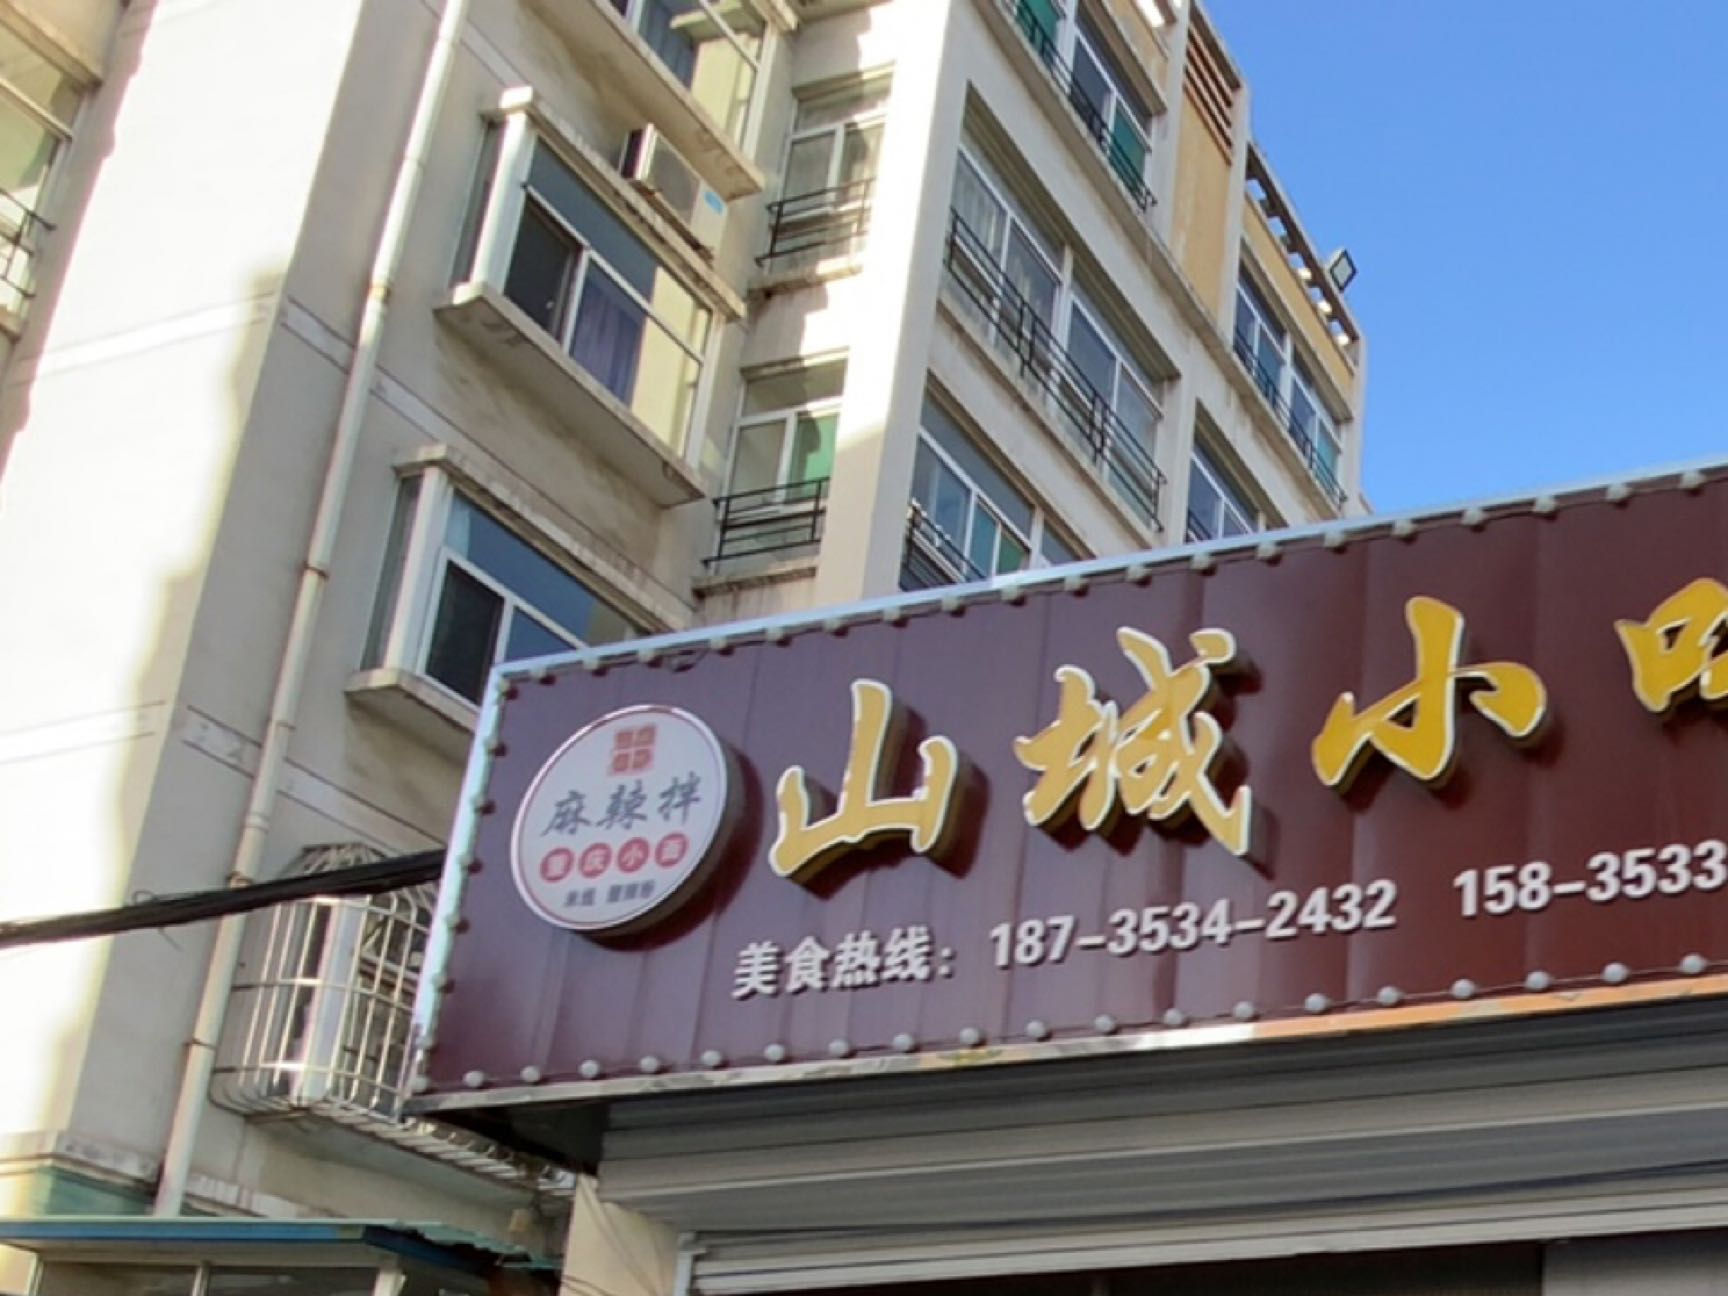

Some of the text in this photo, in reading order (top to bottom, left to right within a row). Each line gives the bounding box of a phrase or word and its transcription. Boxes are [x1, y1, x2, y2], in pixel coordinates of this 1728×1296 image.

[540, 771, 702, 836] 麻辣拌
[990, 879, 1397, 971] 187-3534-2432
